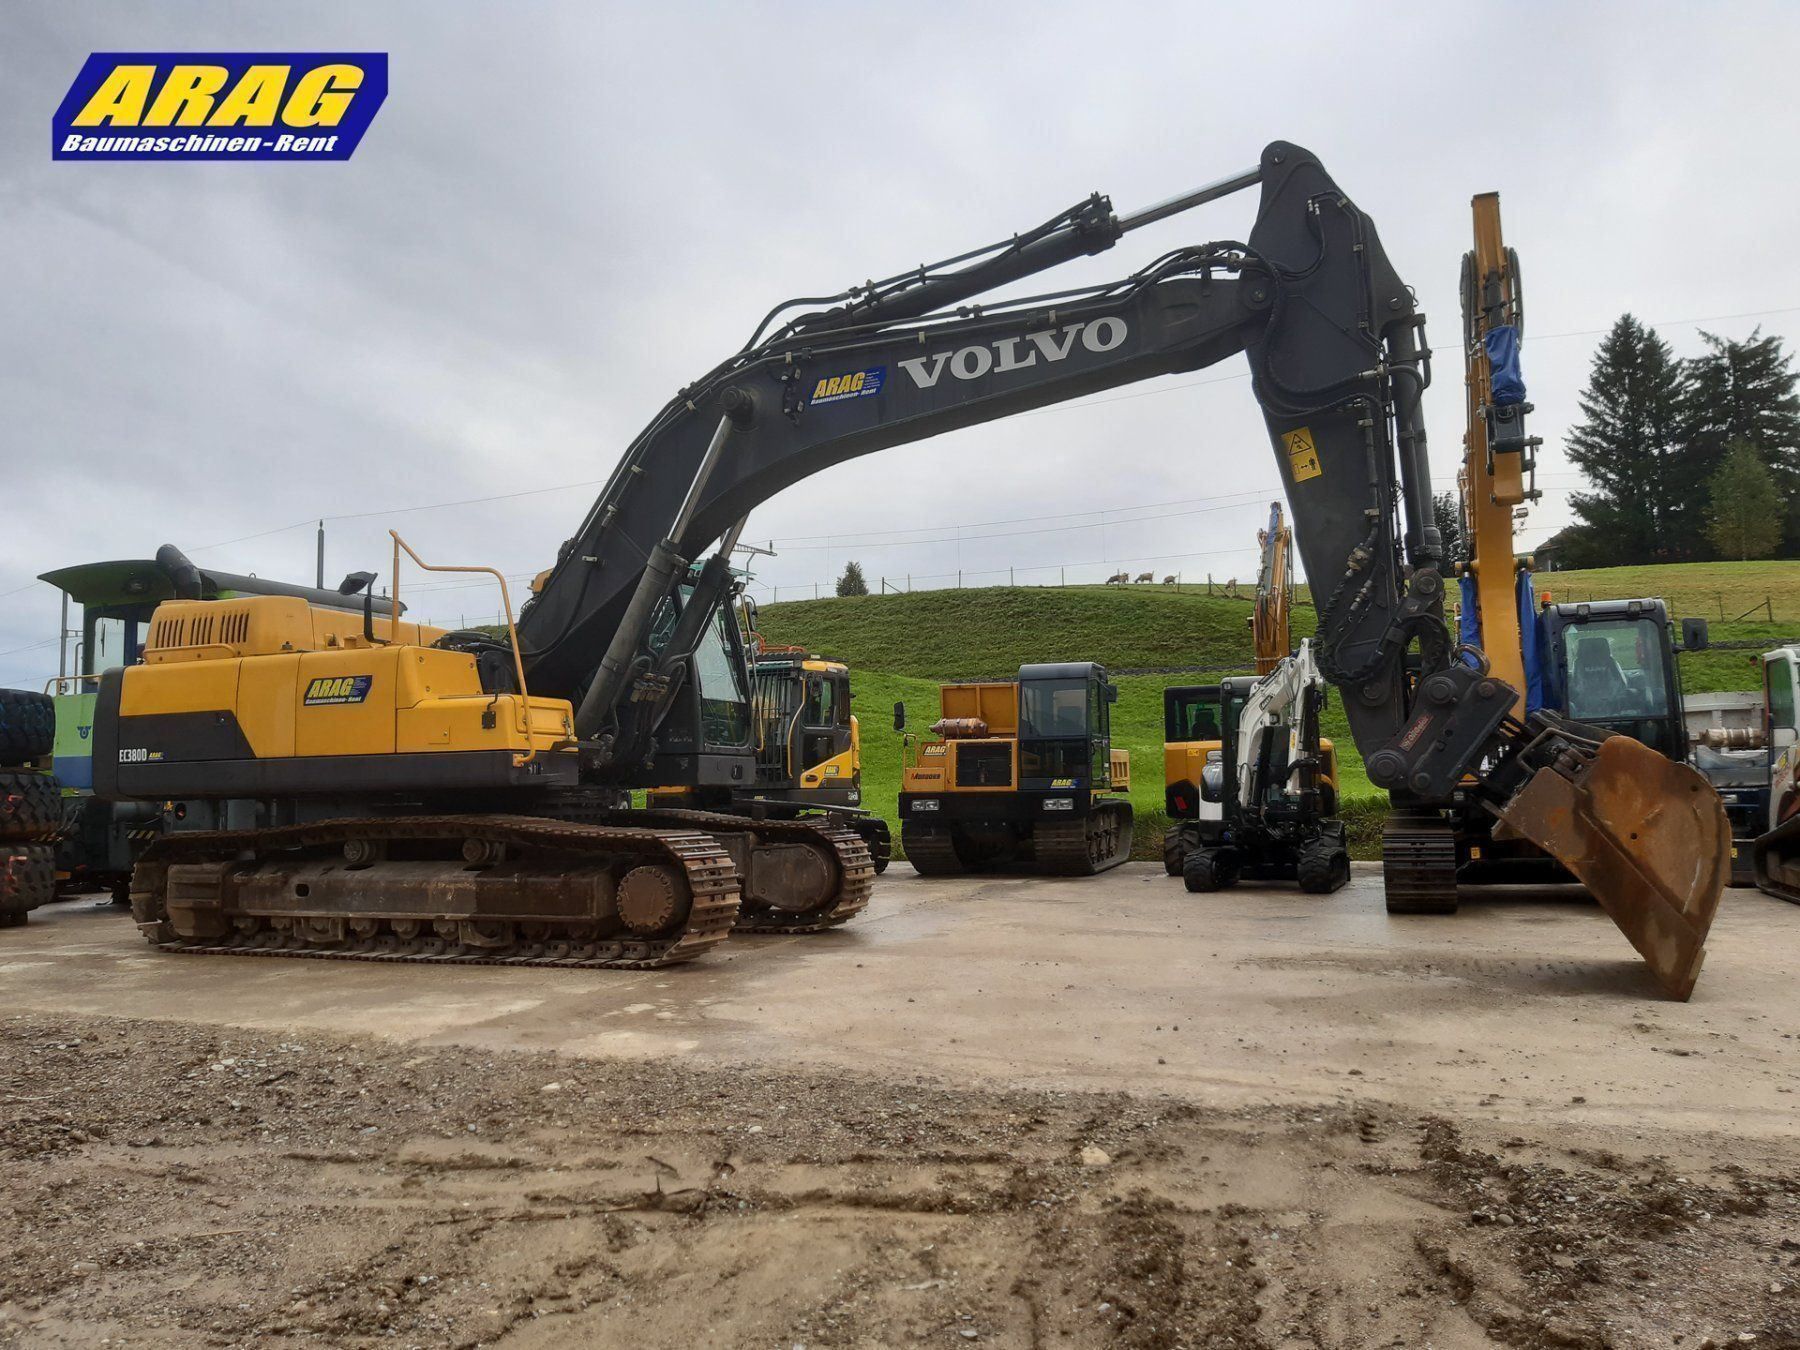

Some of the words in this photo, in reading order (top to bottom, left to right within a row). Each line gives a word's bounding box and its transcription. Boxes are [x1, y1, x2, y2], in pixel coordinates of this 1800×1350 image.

[898, 316, 1127, 388] VOLVO
[812, 371, 866, 399] ARAG
[308, 678, 354, 697] ARAG
[119, 748, 148, 763] EC380D
[924, 745, 947, 753] ARAG
